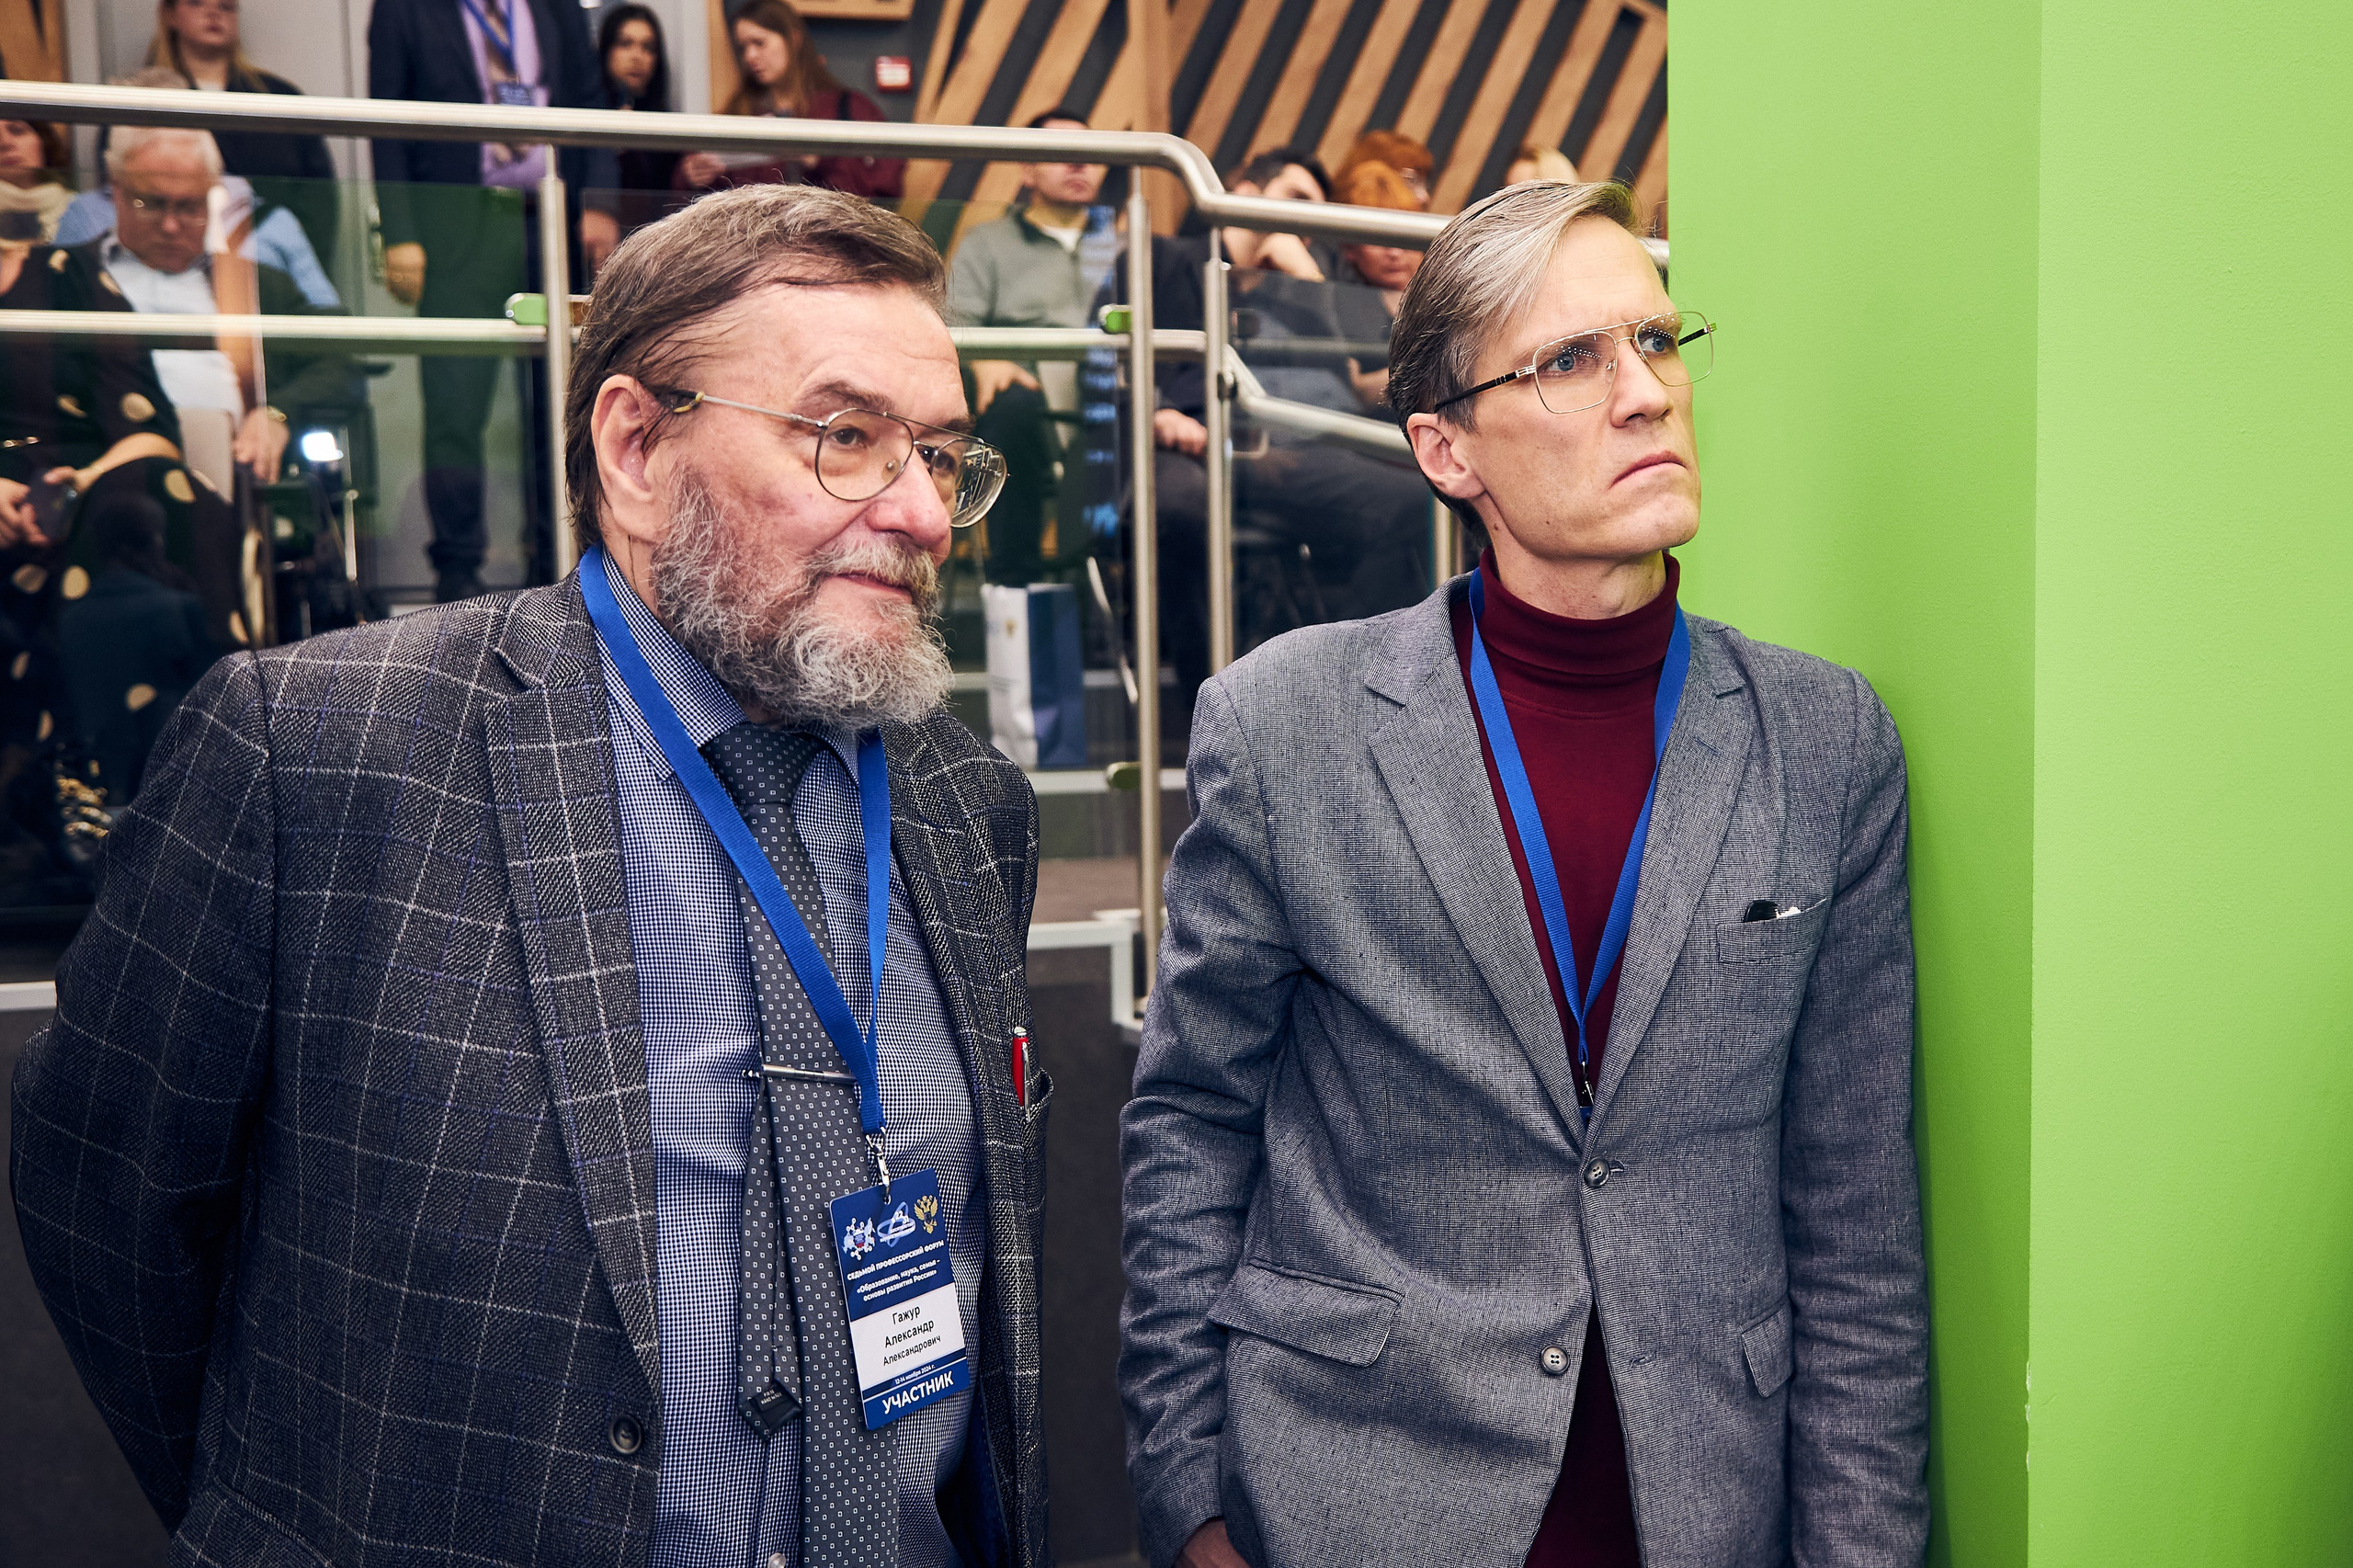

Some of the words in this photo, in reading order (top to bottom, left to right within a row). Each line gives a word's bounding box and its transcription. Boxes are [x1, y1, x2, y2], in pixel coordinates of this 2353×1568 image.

[847, 1264, 876, 1280] СЕДЬМОЙ
[876, 1246, 924, 1270] ПРОФЕССОРСКИЙ
[924, 1240, 944, 1253] ФОРУМ
[901, 1267, 919, 1278] наука,
[919, 1259, 937, 1270] семья
[863, 1289, 886, 1301] основы
[886, 1278, 913, 1294] развития
[892, 1306, 921, 1324] Гажур
[884, 1320, 935, 1348] Александр
[883, 1335, 941, 1366] Александрович
[882, 1370, 954, 1415] УЧАСТНИК
